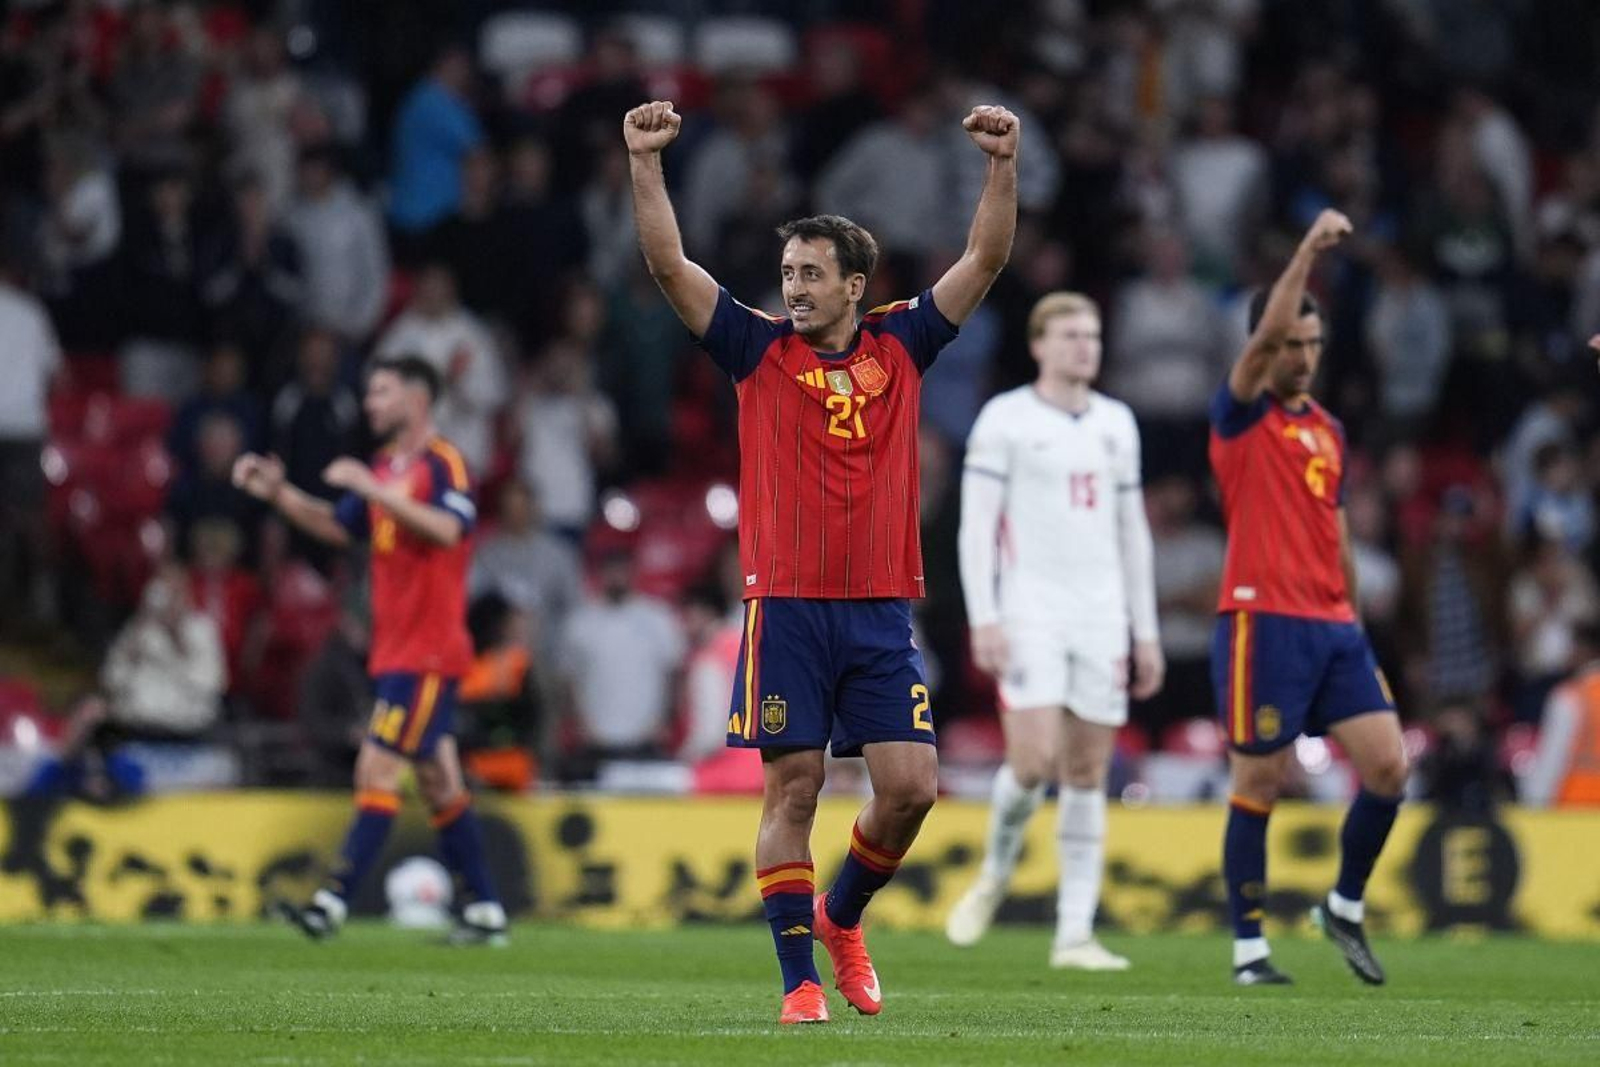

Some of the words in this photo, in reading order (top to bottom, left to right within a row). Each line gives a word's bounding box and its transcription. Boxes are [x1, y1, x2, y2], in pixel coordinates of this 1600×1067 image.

[826, 395, 866, 439] 21
[1069, 472, 1097, 509] 15
[1305, 456, 1326, 499] 6
[910, 683, 933, 732] 2
